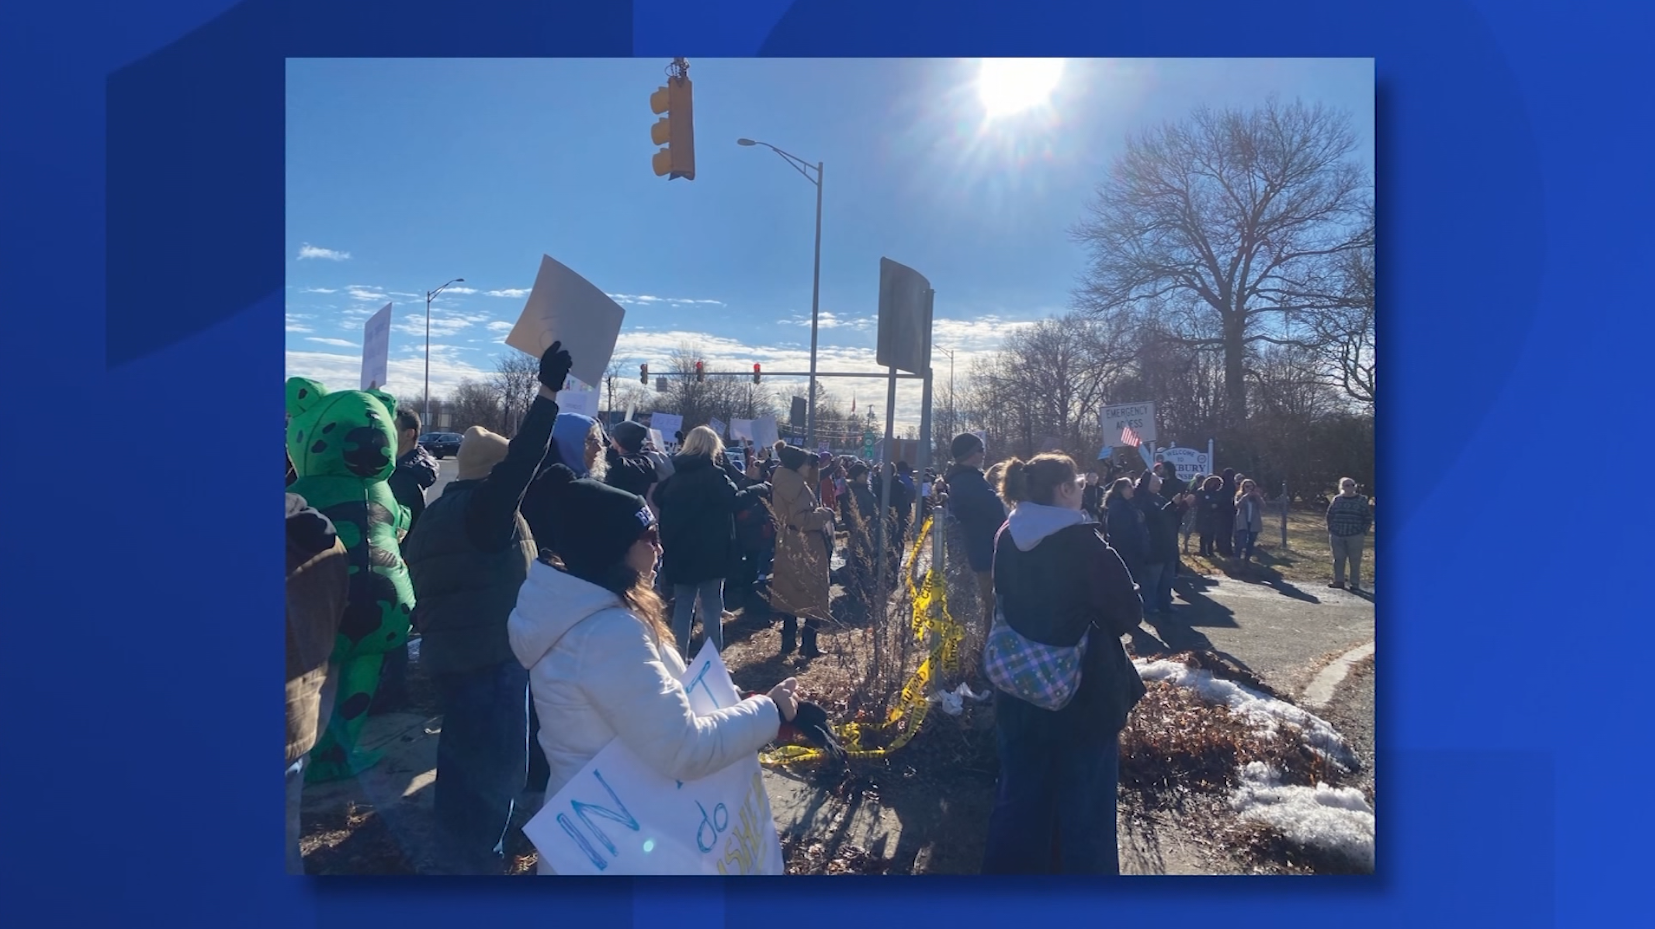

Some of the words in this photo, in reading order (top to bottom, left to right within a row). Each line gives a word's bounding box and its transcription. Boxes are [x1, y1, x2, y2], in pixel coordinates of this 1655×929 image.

[1106, 405, 1148, 419] EMERGENCY
[1166, 449, 1195, 458] WELCOME
[694, 799, 729, 854] do
